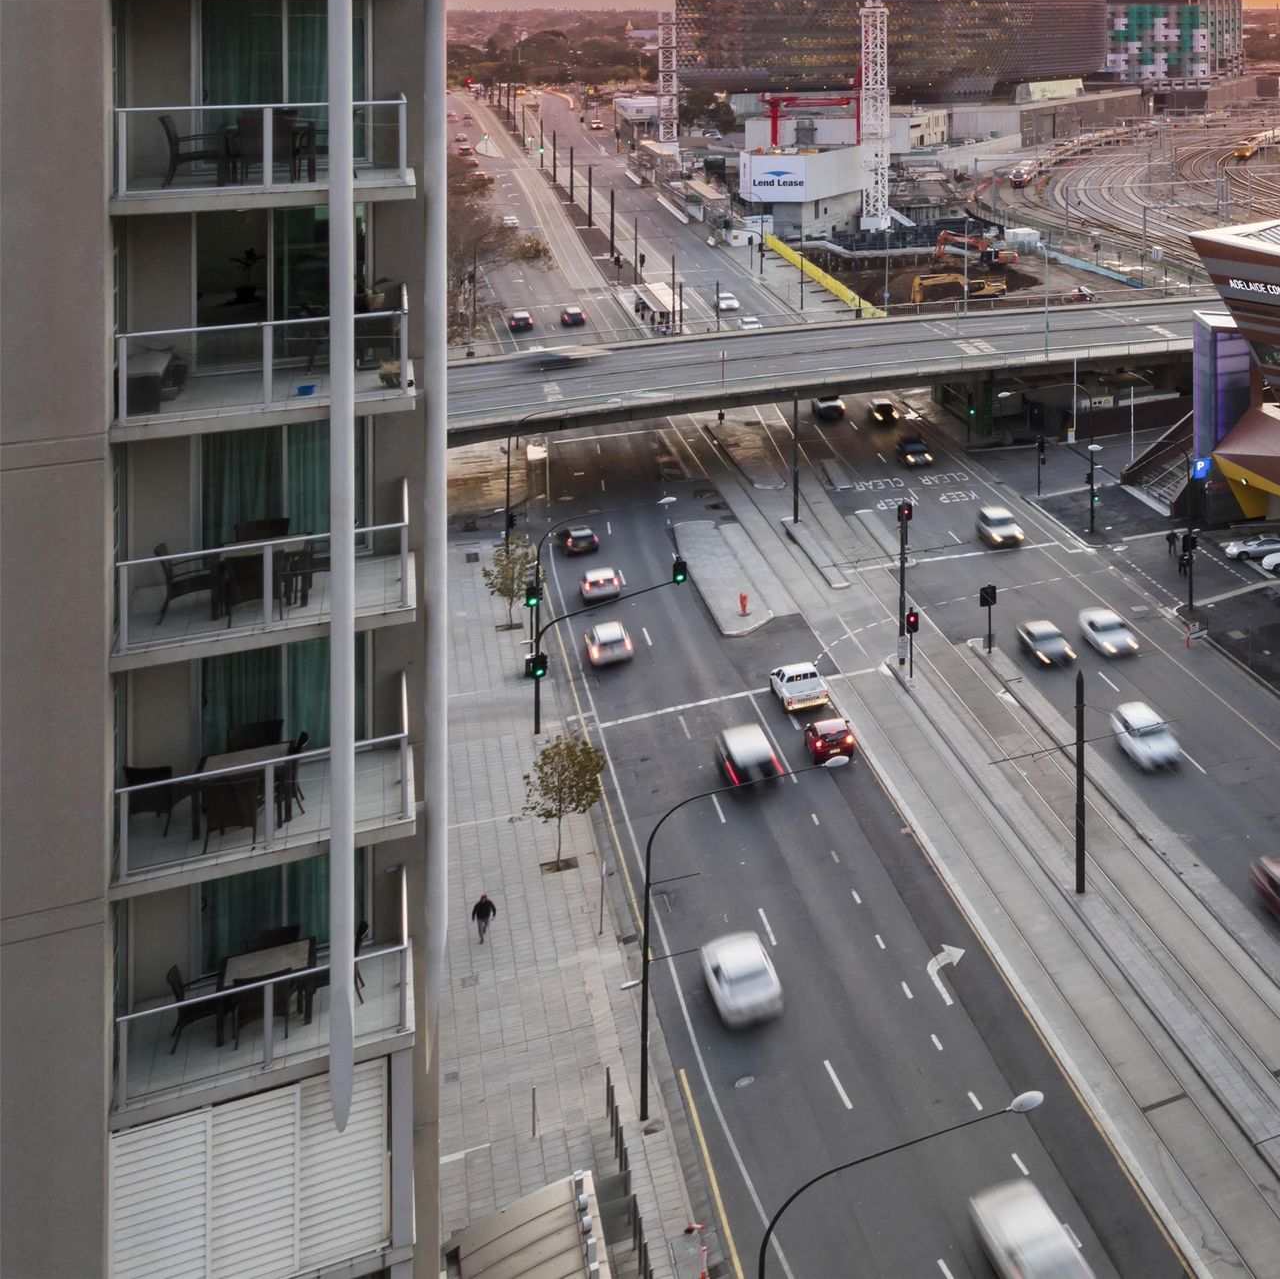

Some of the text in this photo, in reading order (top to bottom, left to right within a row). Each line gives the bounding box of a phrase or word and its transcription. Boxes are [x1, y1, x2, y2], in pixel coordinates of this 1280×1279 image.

[752, 179, 804, 187] Lend Lease
[1229, 279, 1268, 294] ADELAIDE
[1197, 461, 1205, 471] P
[853, 477, 905, 491] CLEAR
[918, 472, 969, 485] CLEAR
[939, 490, 980, 503] KEEP
[797, 695, 820, 703] TOYOTA
